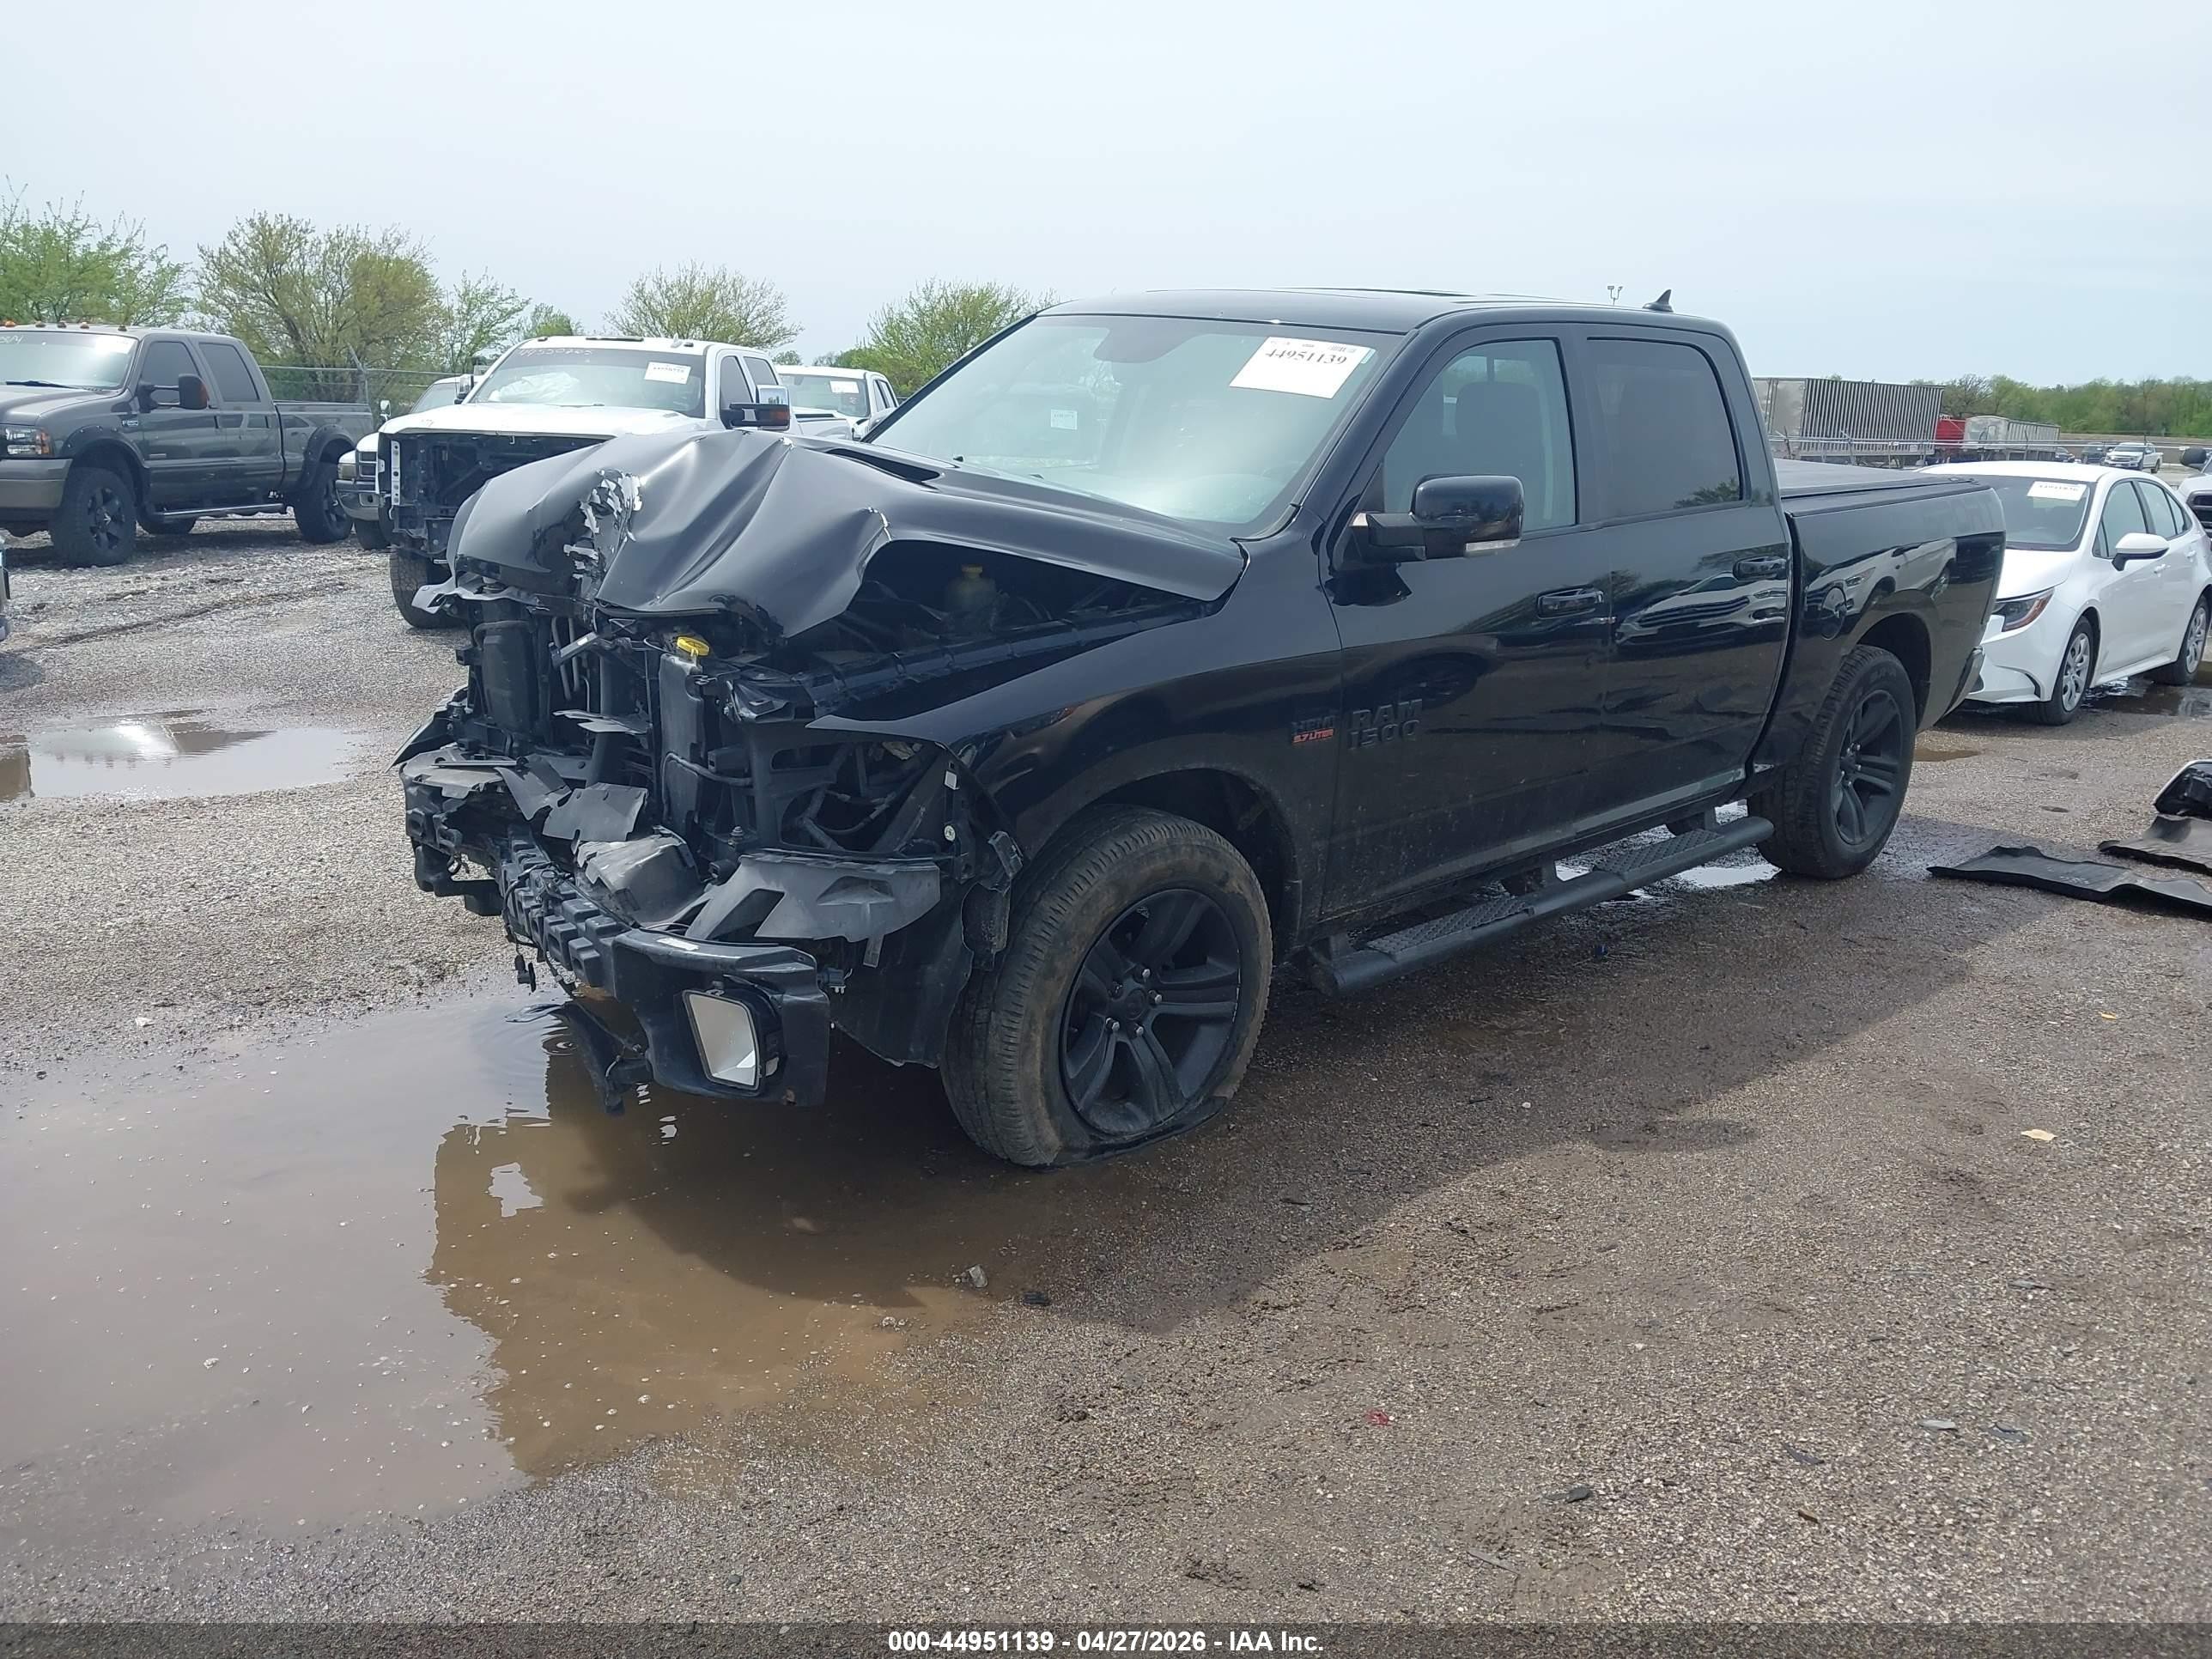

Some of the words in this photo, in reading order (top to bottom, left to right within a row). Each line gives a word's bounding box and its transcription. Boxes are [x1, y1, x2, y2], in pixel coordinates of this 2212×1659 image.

[1265, 348, 1347, 365] 44951139
[1351, 698, 1423, 730] RAM
[1347, 720, 1420, 751] 1500
